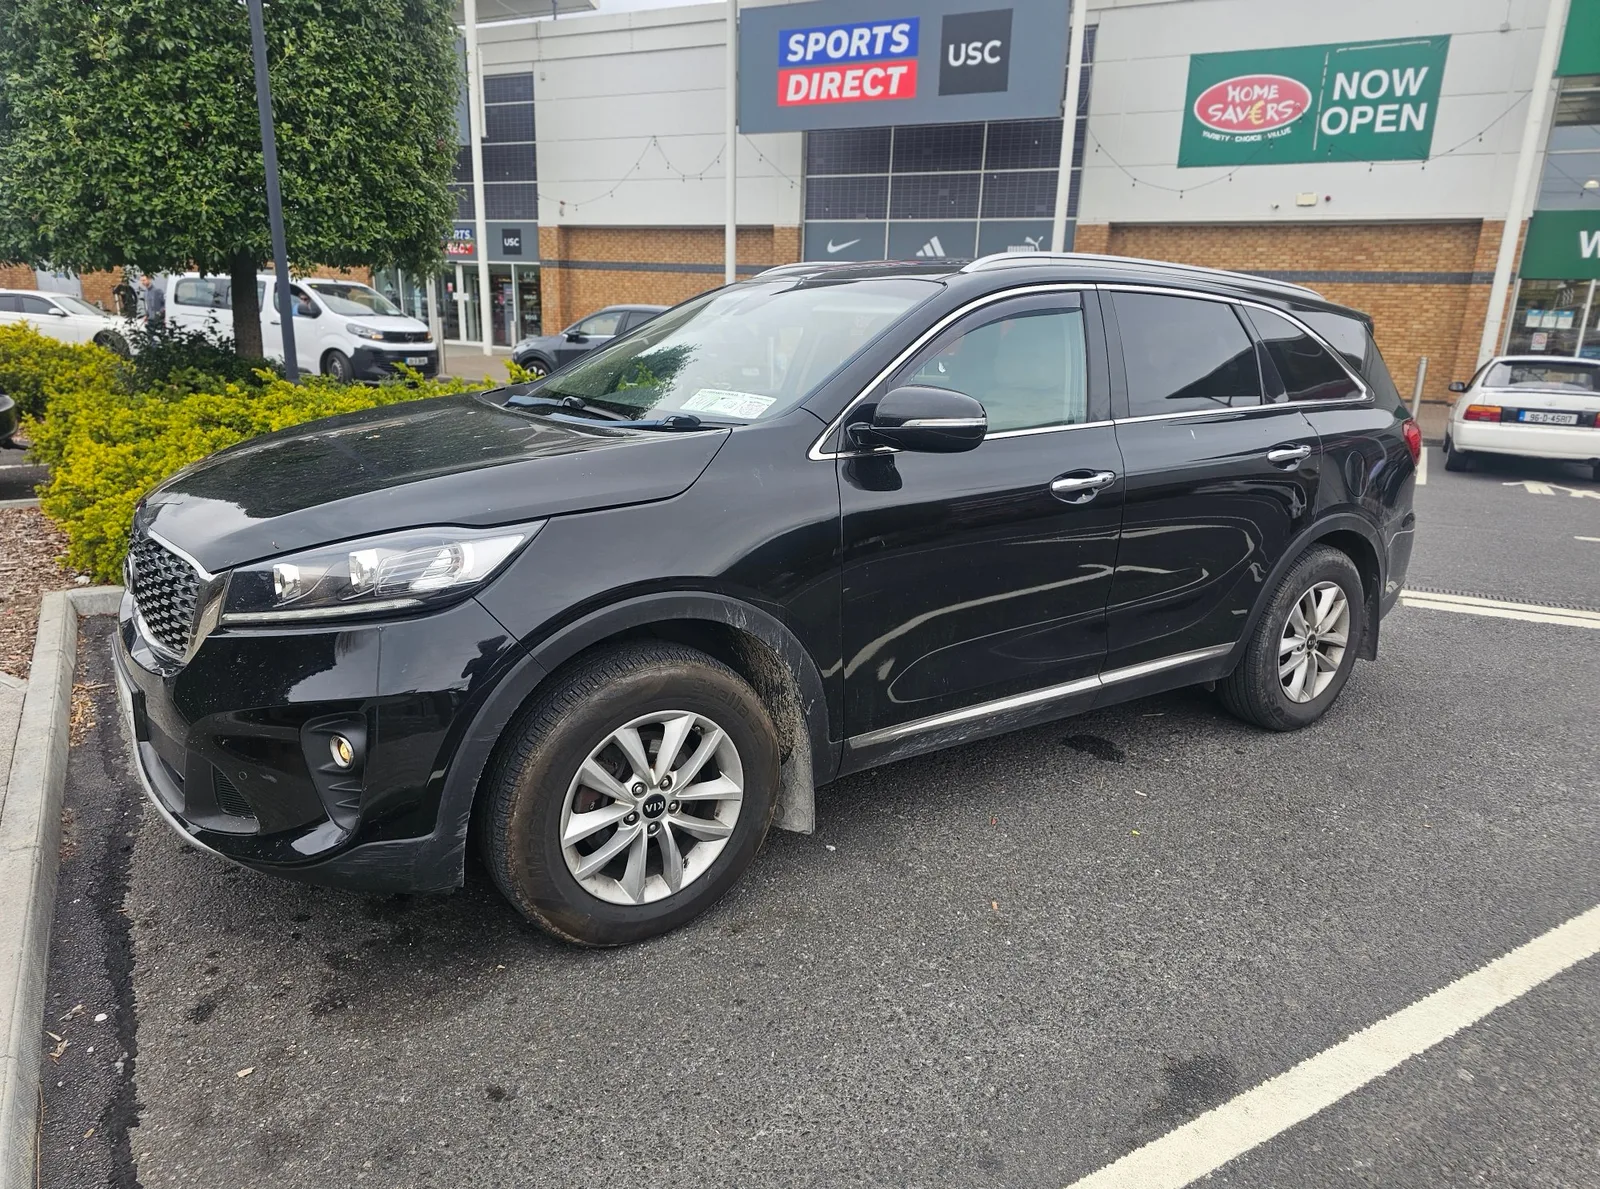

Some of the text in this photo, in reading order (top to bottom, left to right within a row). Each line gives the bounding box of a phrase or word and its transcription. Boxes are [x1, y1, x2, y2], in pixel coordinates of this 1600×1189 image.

[786, 22, 911, 63] SPORTS
[948, 40, 1002, 67] USC
[786, 65, 908, 102] DIRECT
[1227, 84, 1280, 103] HOME
[1332, 66, 1429, 101] NOW
[1320, 102, 1429, 136] OPEN
[1202, 126, 1293, 143] VARIETY CHOICE VALUE
[503, 238, 520, 247] USC
[644, 800, 664, 813] KIA
